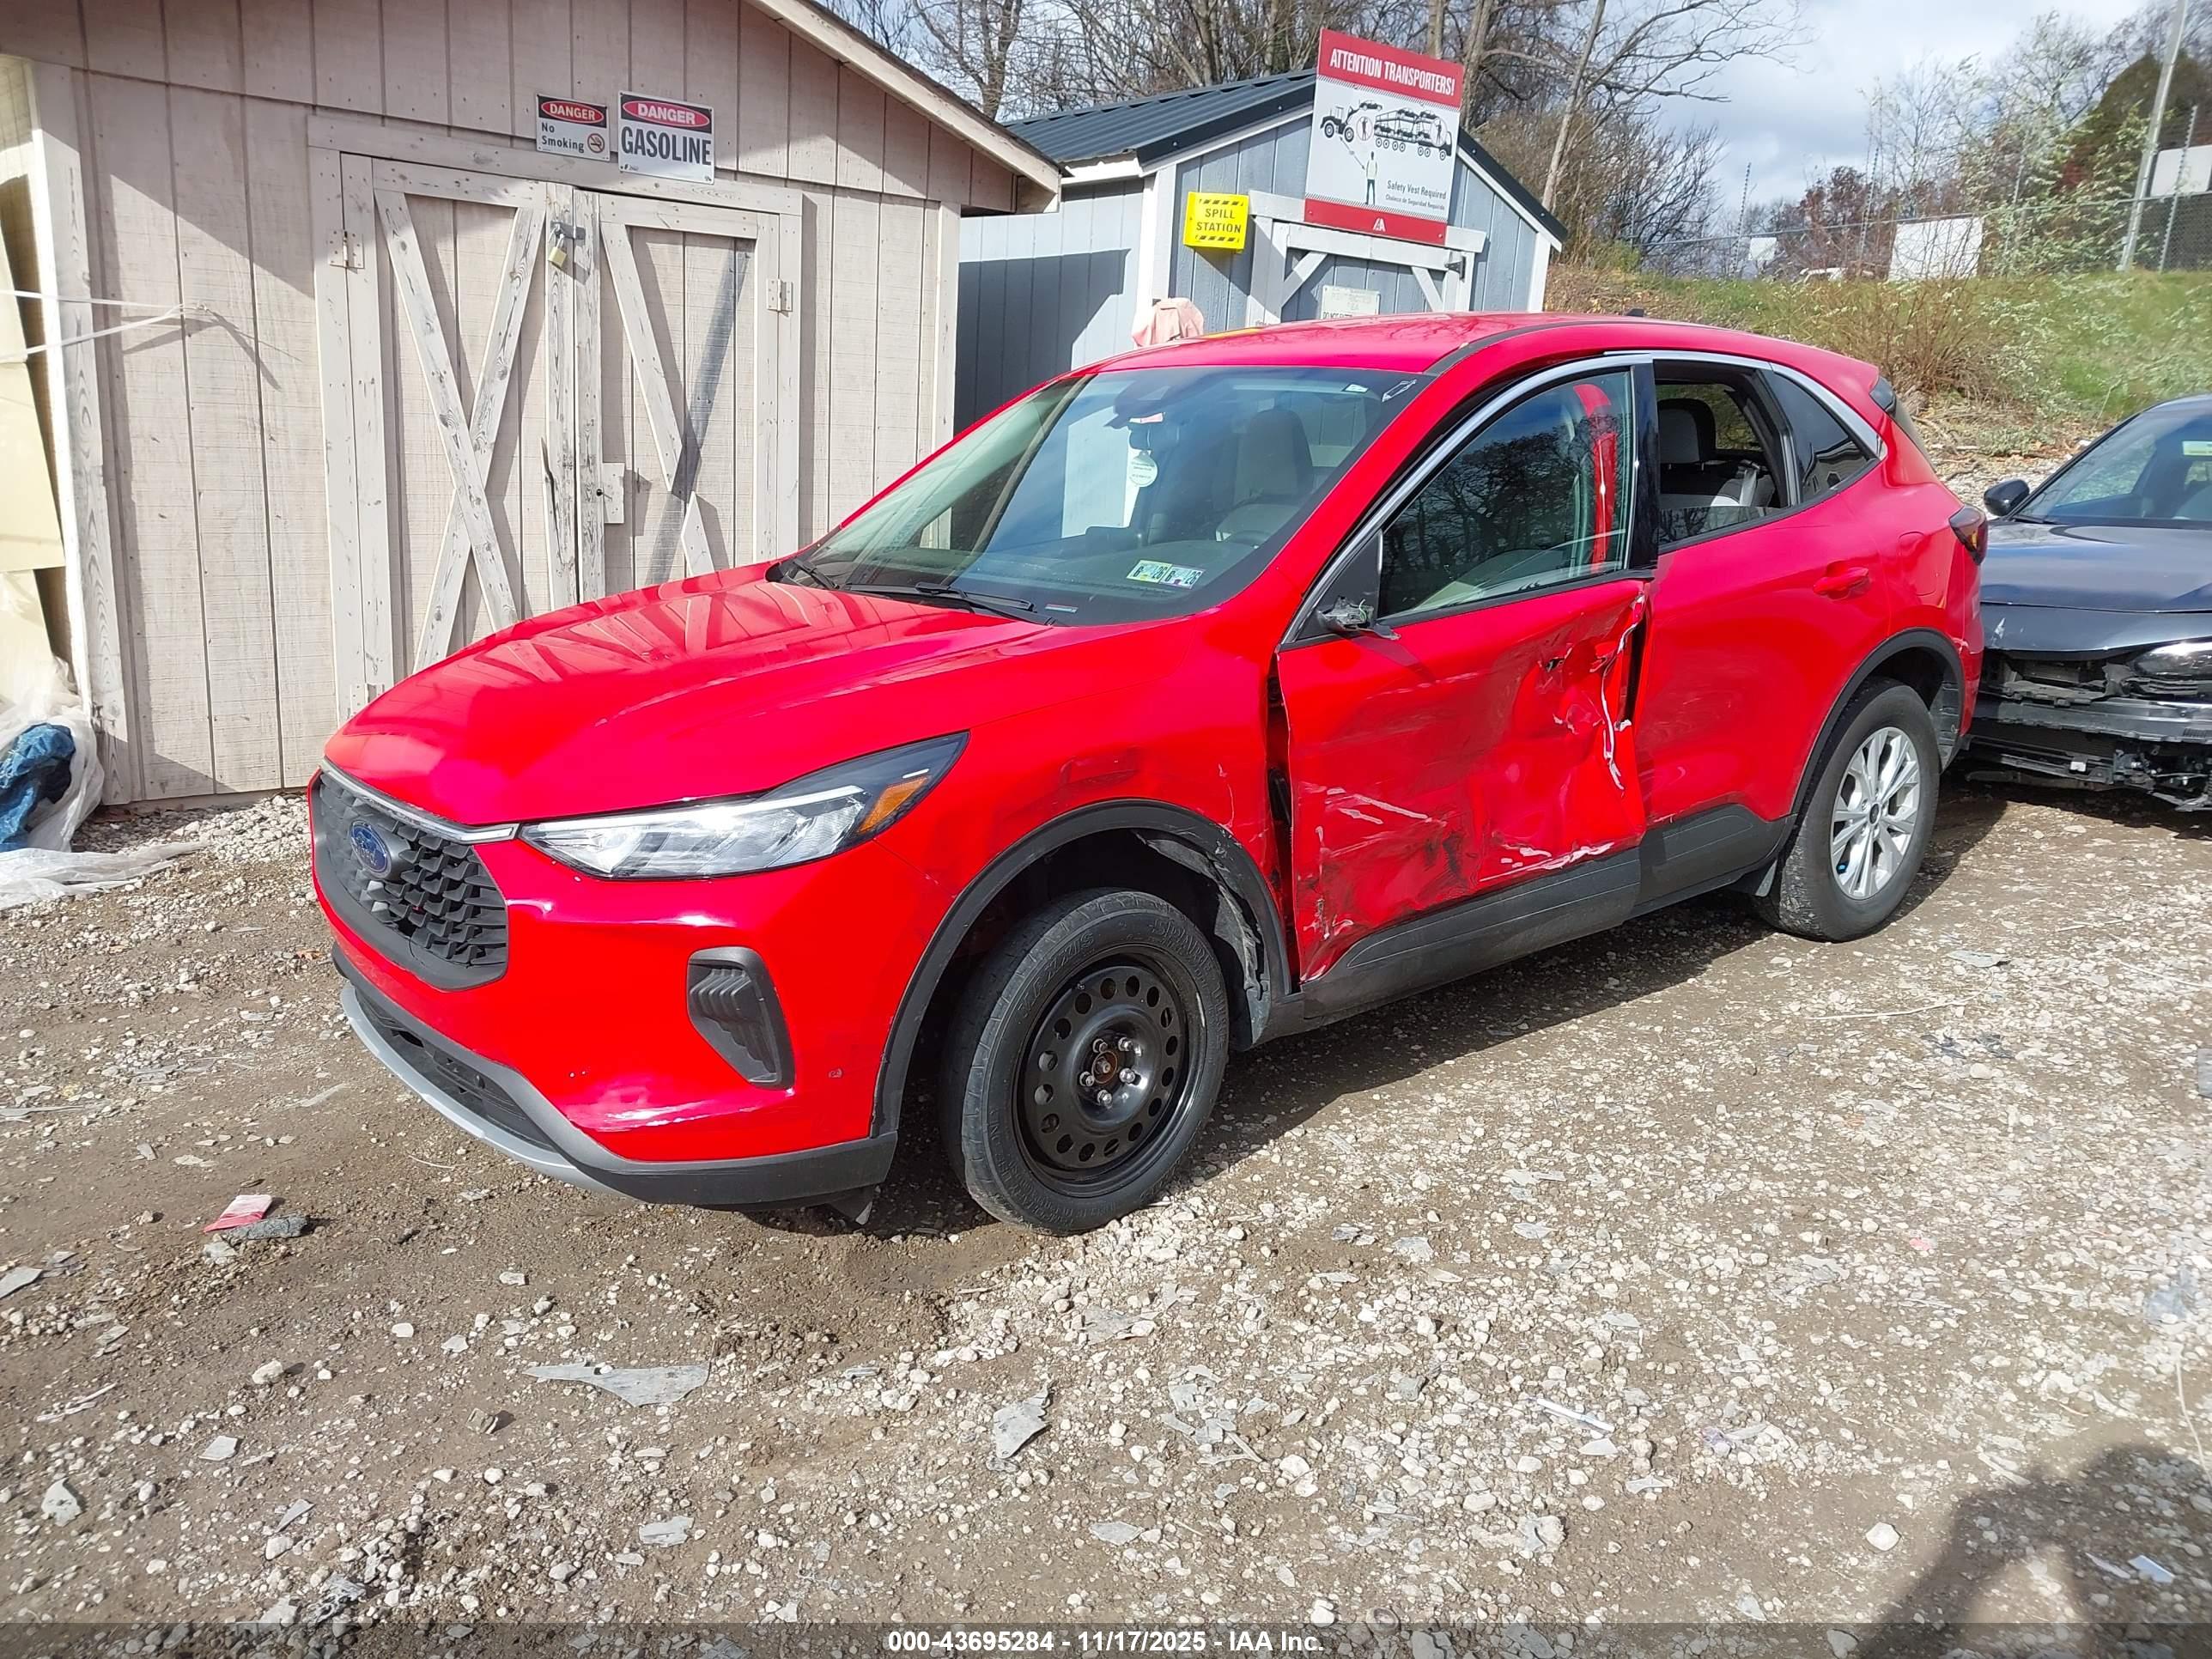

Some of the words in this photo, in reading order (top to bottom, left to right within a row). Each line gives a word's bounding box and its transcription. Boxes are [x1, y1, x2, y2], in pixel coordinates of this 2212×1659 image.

[1329, 48, 1382, 78] ATTENTION
[1384, 61, 1455, 96] TRANSPORTERS!
[550, 103, 596, 121] DANGER
[637, 103, 696, 125] DANGER
[542, 122, 555, 133] No
[542, 136, 585, 153] Smoking
[621, 126, 712, 166] GASOLINE
[1387, 180, 1407, 193] Safety
[1407, 184, 1420, 194] Vest
[1421, 186, 1447, 199] Required
[1205, 208, 1236, 219] SPILL
[1196, 222, 1242, 234] STATION
[1133, 566, 1144, 577] 6
[1165, 570, 1176, 581] 6
